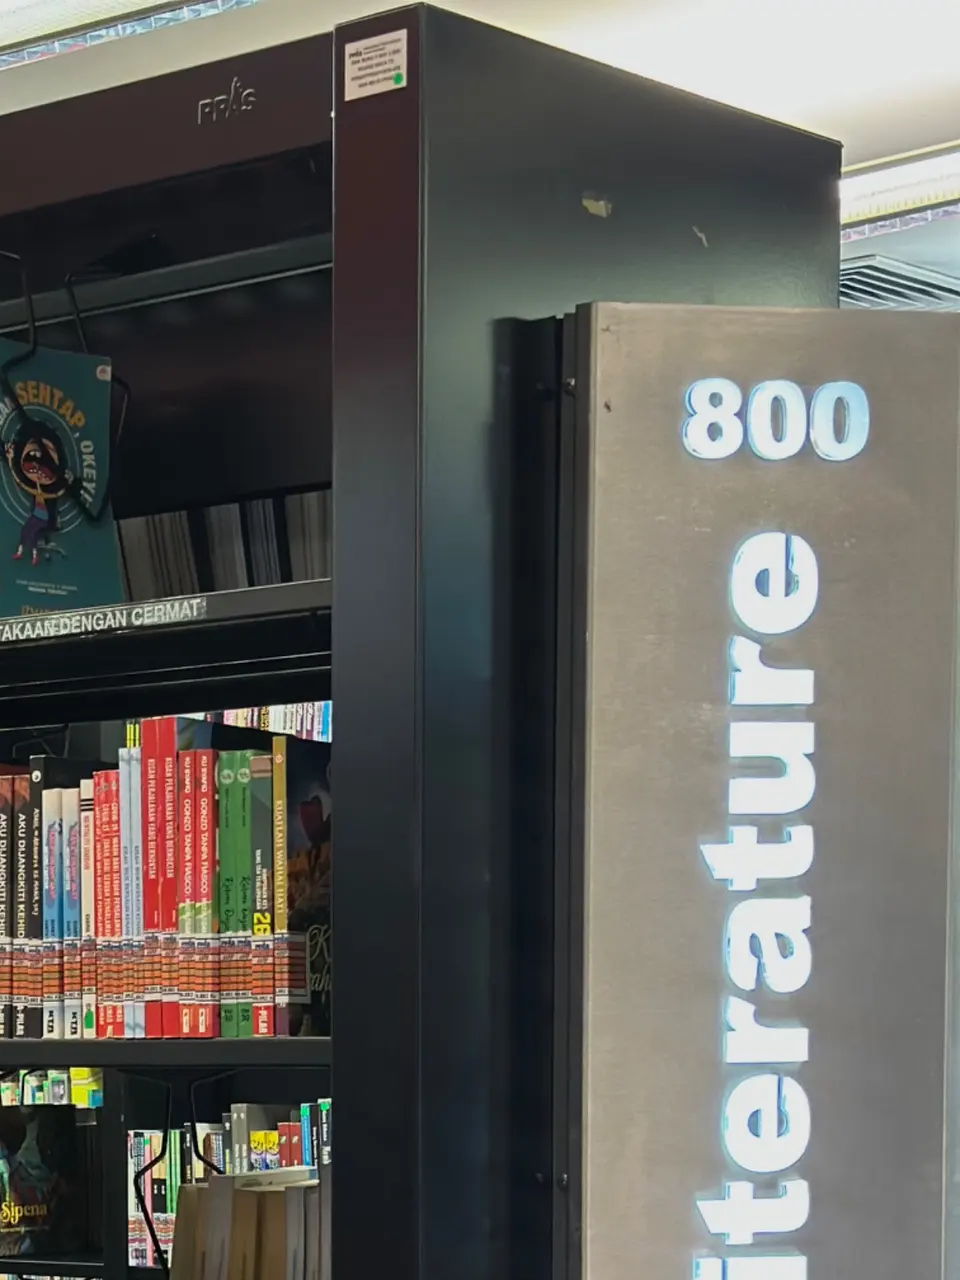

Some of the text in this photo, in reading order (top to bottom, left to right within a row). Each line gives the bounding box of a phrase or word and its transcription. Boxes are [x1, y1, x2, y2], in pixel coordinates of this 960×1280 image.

[682, 377, 871, 461] 800
[57, 610, 127, 635] DENGAN
[131, 599, 201, 625] CERMAT
[18, 814, 26, 837] AKU
[184, 799, 192, 831] GONZO
[200, 798, 208, 830] GONZO
[184, 834, 192, 860] TANPA
[200, 832, 208, 859] TANPA
[0, 840, 7, 901] DIJANGKITI
[17, 840, 26, 901] DIJANGKITI
[253, 912, 271, 935] 26
